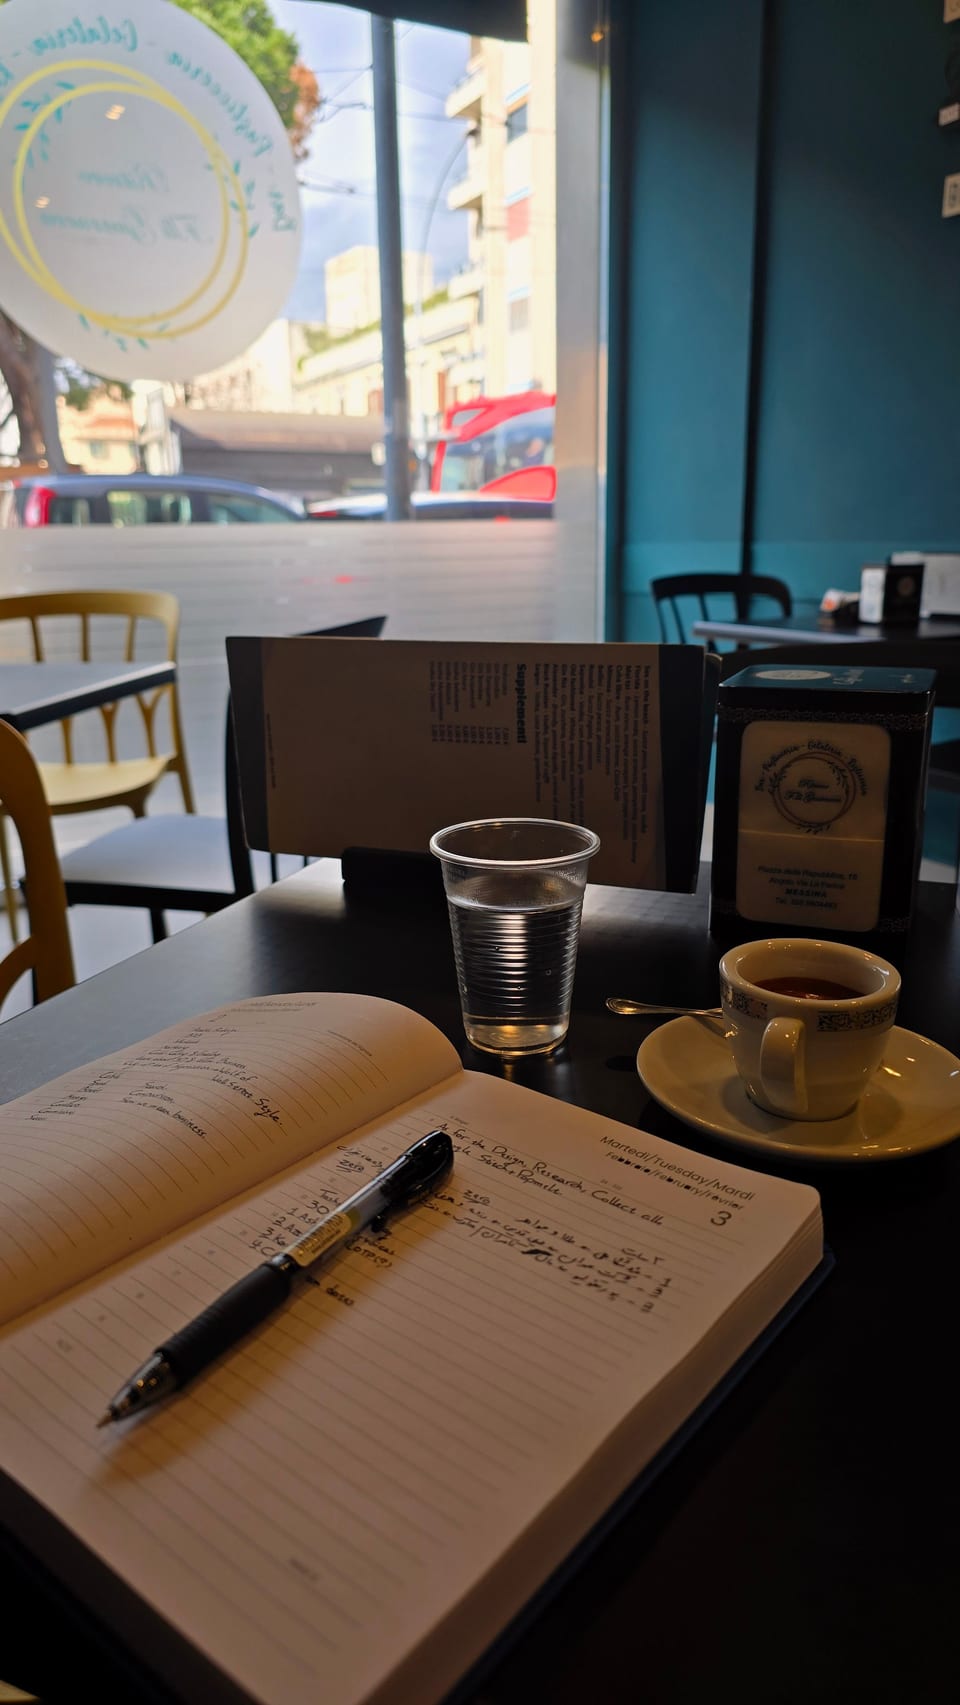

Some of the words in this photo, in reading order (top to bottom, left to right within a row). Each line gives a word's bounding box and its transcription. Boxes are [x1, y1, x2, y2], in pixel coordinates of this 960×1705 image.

[516, 663, 528, 744] Supplementi
[784, 888, 827, 898] MESSINA
[307, 1200, 330, 1216] 30
[590, 1189, 637, 1216] Collect
[710, 1210, 733, 1227] 3
